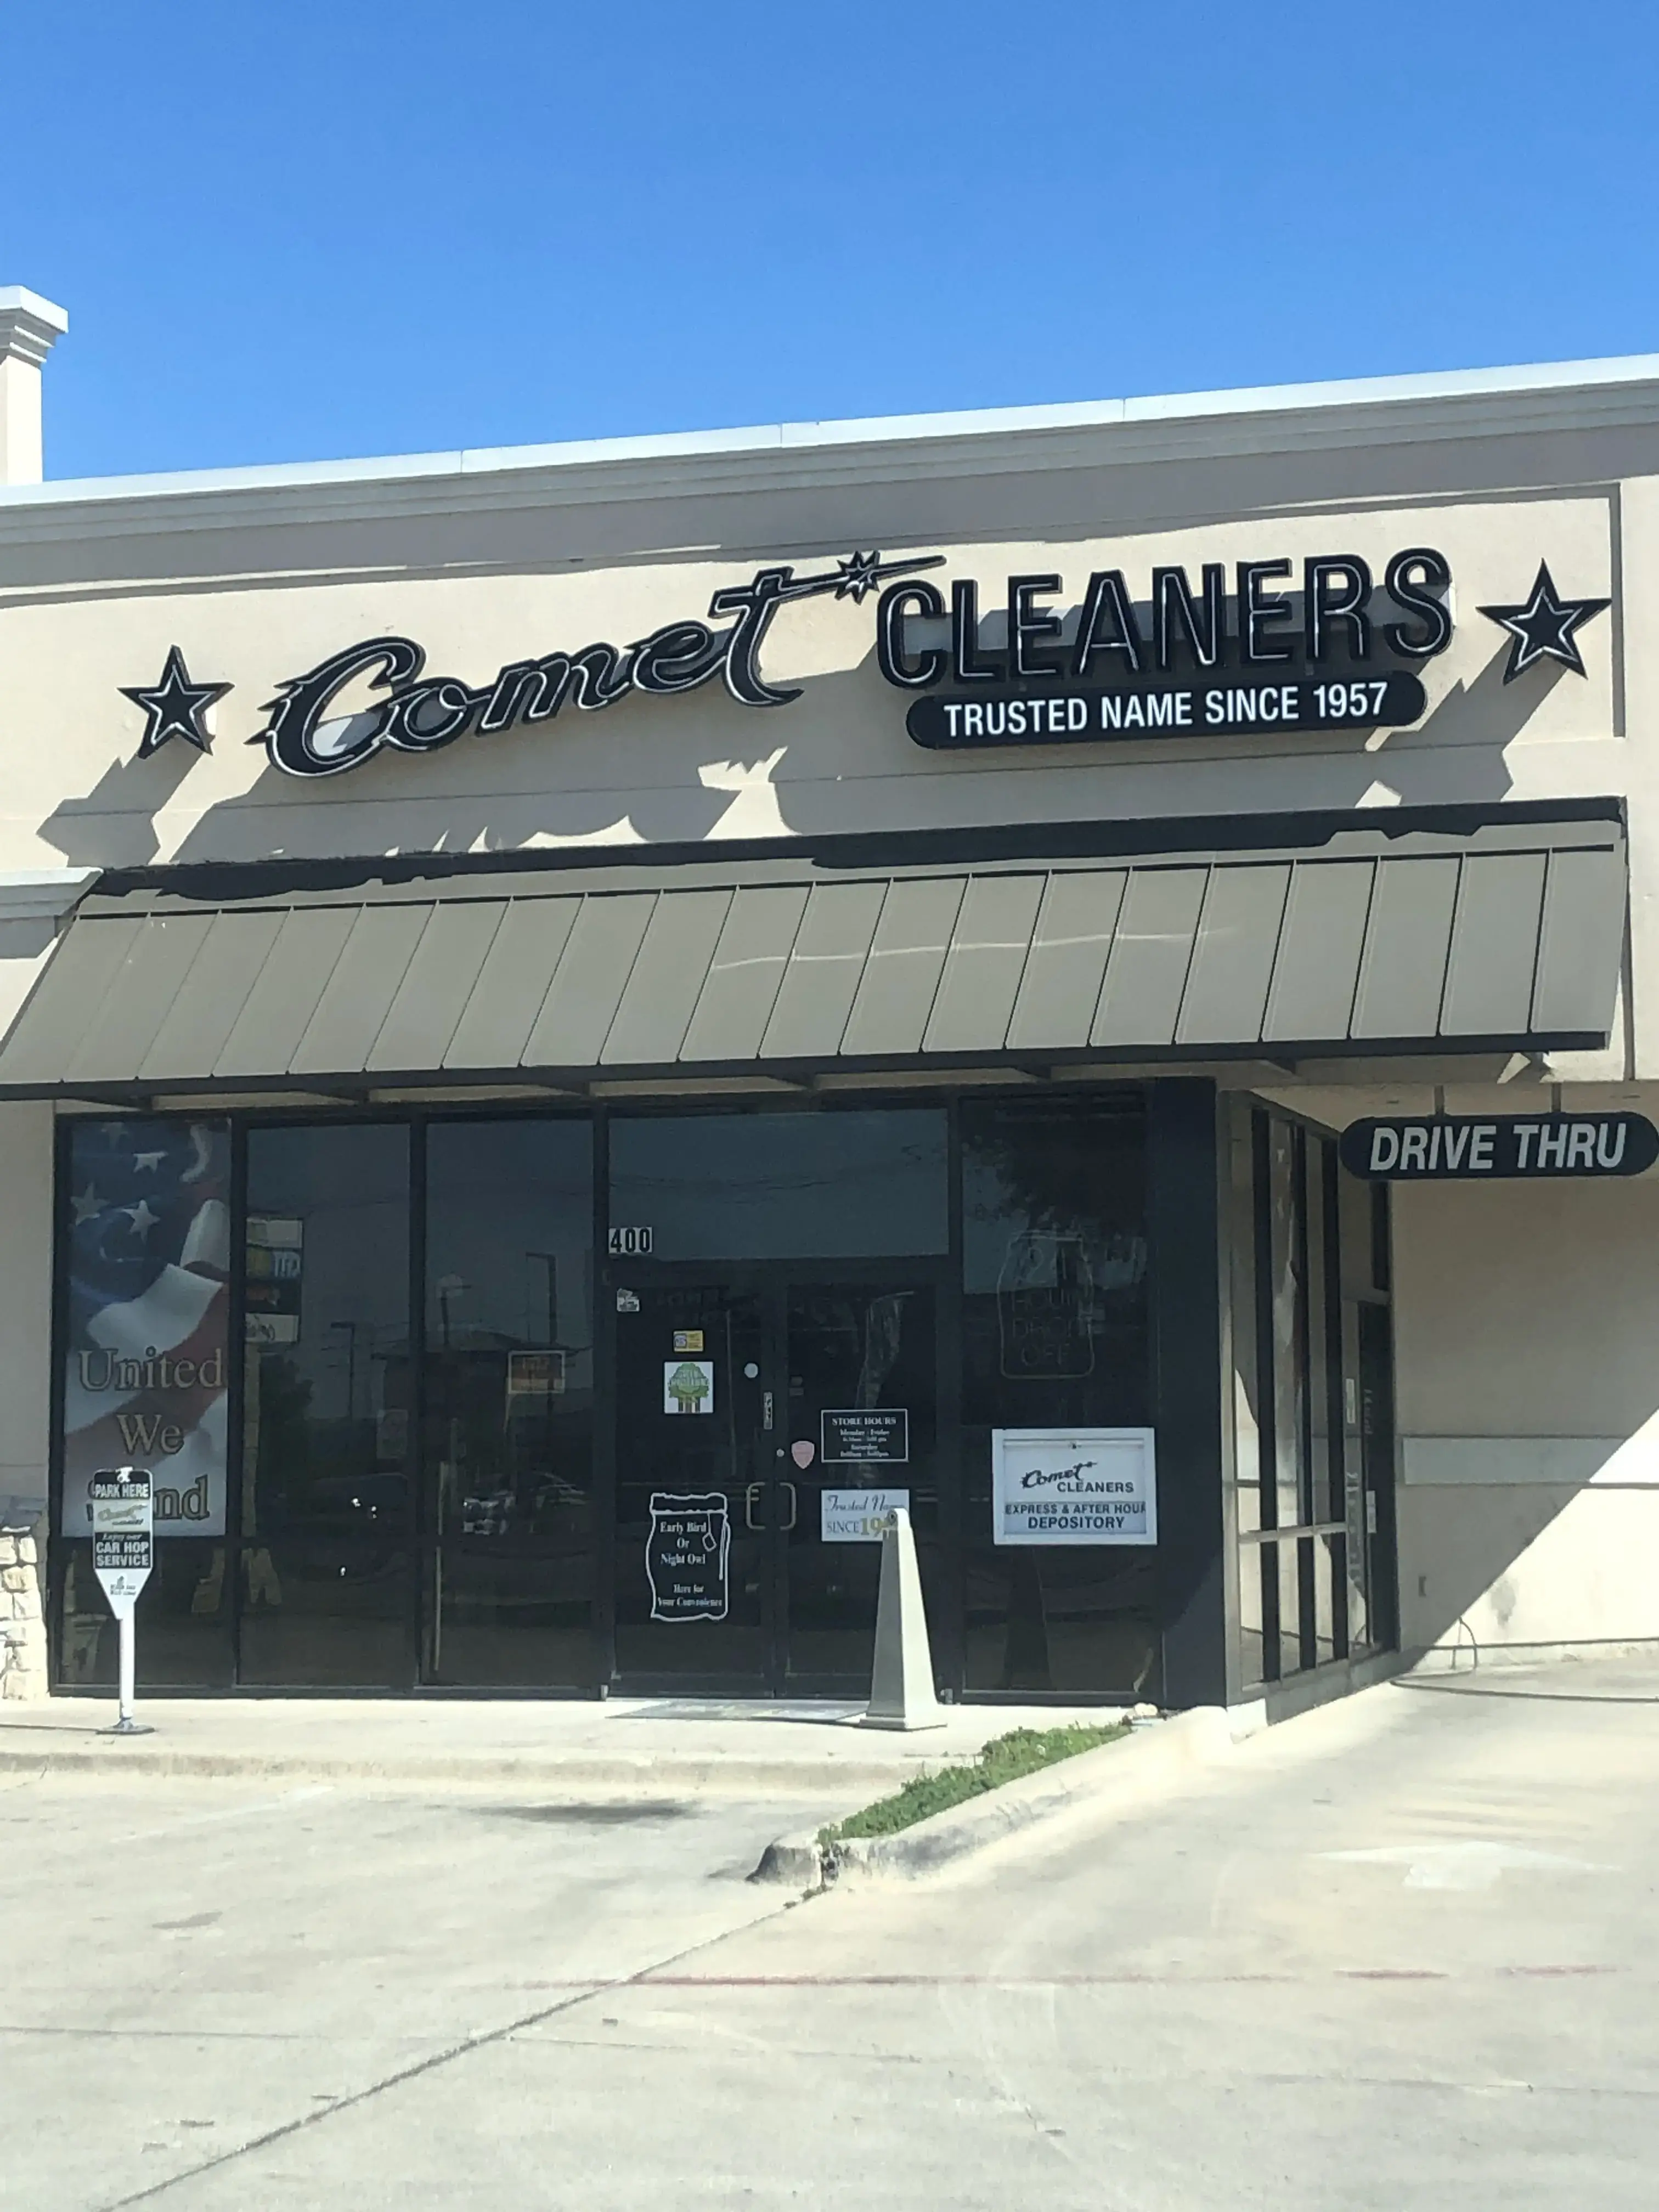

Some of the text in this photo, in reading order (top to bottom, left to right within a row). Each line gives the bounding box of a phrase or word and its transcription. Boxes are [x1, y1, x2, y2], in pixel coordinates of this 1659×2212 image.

[877, 548, 1454, 690] CLEANERS
[245, 565, 805, 777] Comet
[944, 682, 1389, 737] TRUSTED NAME SINCE 1957
[1369, 1122, 1627, 1171] DRIVE THRU
[610, 1227, 651, 1253] 400
[78, 1346, 223, 1391] United
[832, 1417, 896, 1426] STORE HOURS
[116, 1414, 185, 1456] We
[1020, 1462, 1084, 1488] Comet
[95, 1483, 149, 1498] PARK HERE
[1057, 1482, 1135, 1493] CLEANERS
[1005, 1504, 1058, 1515] EXPRESS
[1061, 1504, 1070, 1514] &
[1073, 1504, 1109, 1514] AFTER
[660, 1522, 707, 1535] Early Bird
[827, 1521, 860, 1534] SINCE
[1028, 1516, 1125, 1530] DEPOSITORY
[96, 1542, 149, 1553] CAR HOP
[676, 1537, 690, 1549] Or
[96, 1554, 149, 1566] SERVICE
[661, 1553, 685, 1566] Night
